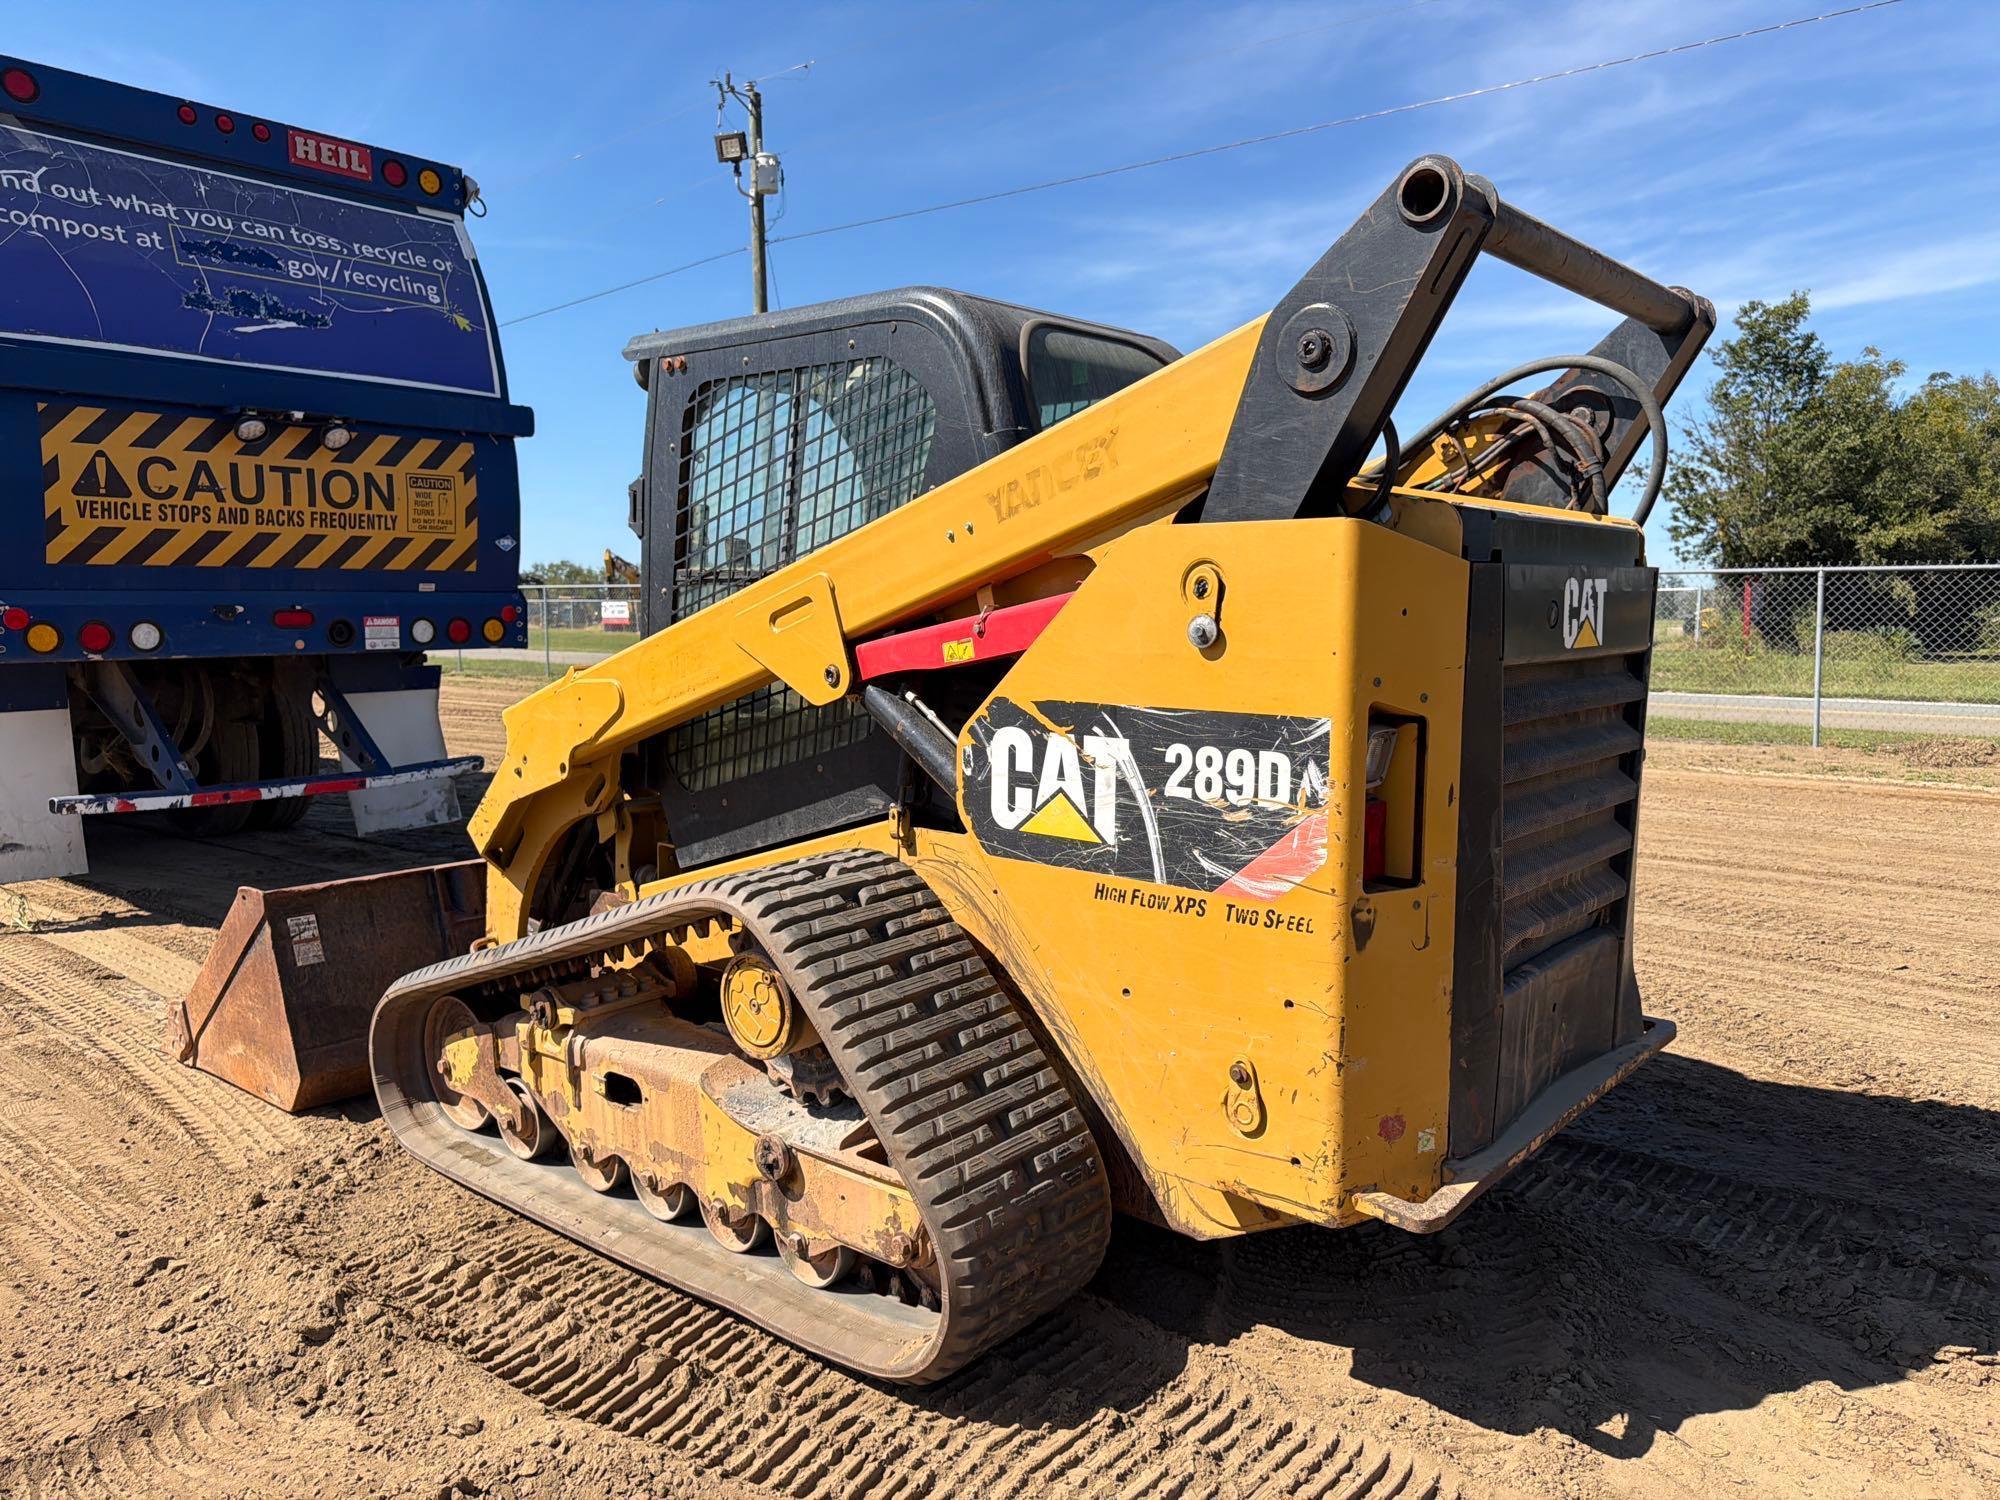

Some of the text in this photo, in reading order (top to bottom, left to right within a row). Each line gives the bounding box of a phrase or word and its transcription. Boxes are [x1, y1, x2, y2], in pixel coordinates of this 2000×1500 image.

[295, 136, 368, 174] HEIL
[51, 183, 102, 206] out
[108, 194, 180, 220] what
[184, 209, 233, 230] you
[241, 220, 285, 241] can
[290, 227, 348, 255] toss,
[352, 242, 428, 268] recycle
[136, 232, 165, 250] at
[137, 455, 395, 512] CAUTION
[410, 478, 451, 489] CAUTION
[76, 499, 398, 531] VEHICLE STOPS AND BACKS FREQUENTLY
[1562, 577, 1608, 649] CAT
[991, 726, 1130, 846] CAT
[1164, 743, 1291, 811] 289D
[1173, 895, 1208, 917] XPS
